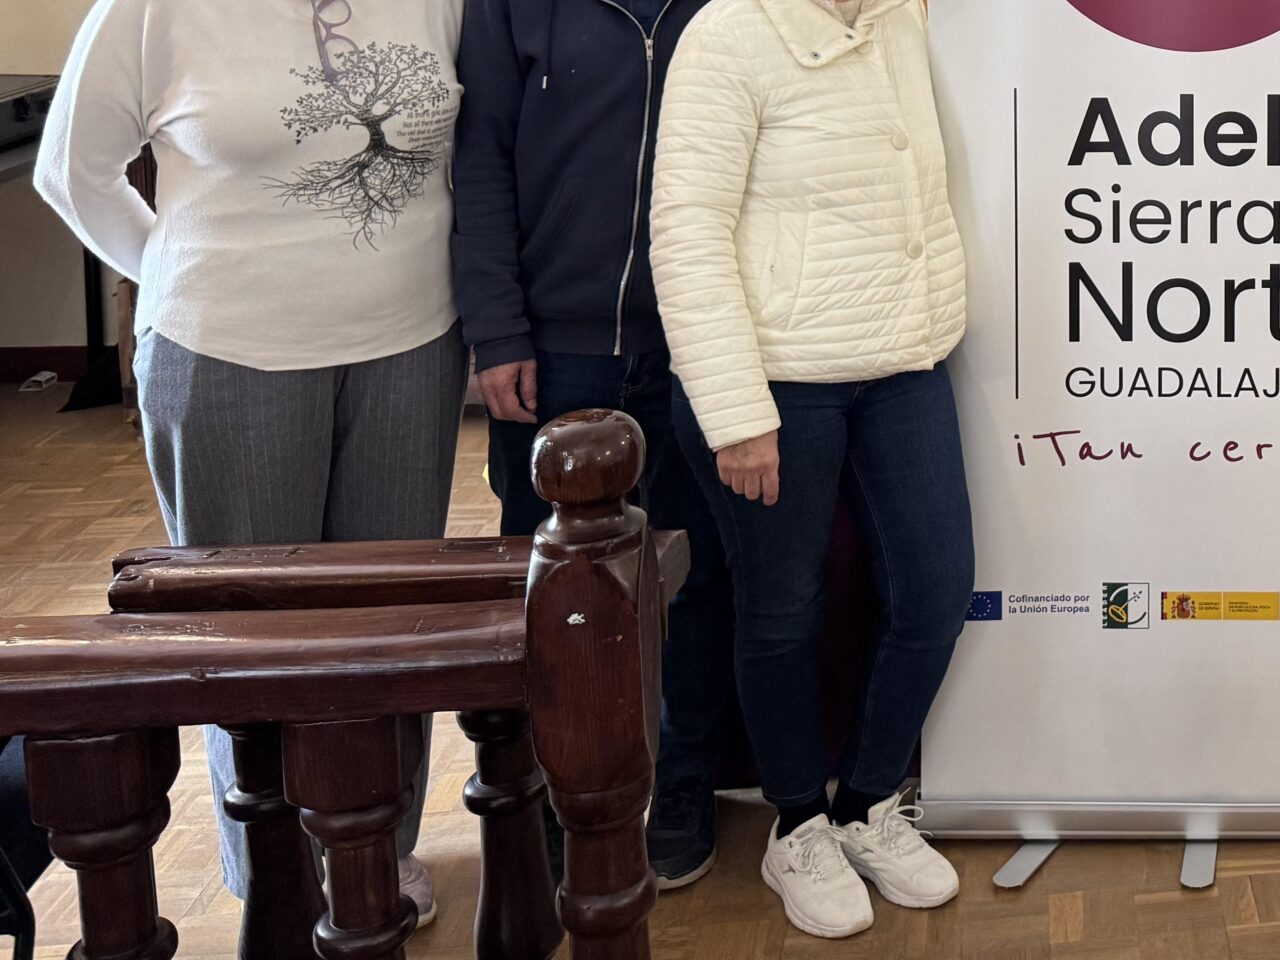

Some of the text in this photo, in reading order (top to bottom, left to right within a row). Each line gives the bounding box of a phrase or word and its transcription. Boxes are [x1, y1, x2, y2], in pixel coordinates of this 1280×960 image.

[1013, 430, 1143, 467] ¡Tan
[1008, 594, 1090, 604] Cofinanciado por
[1008, 604, 1090, 615] la Unión Europea
